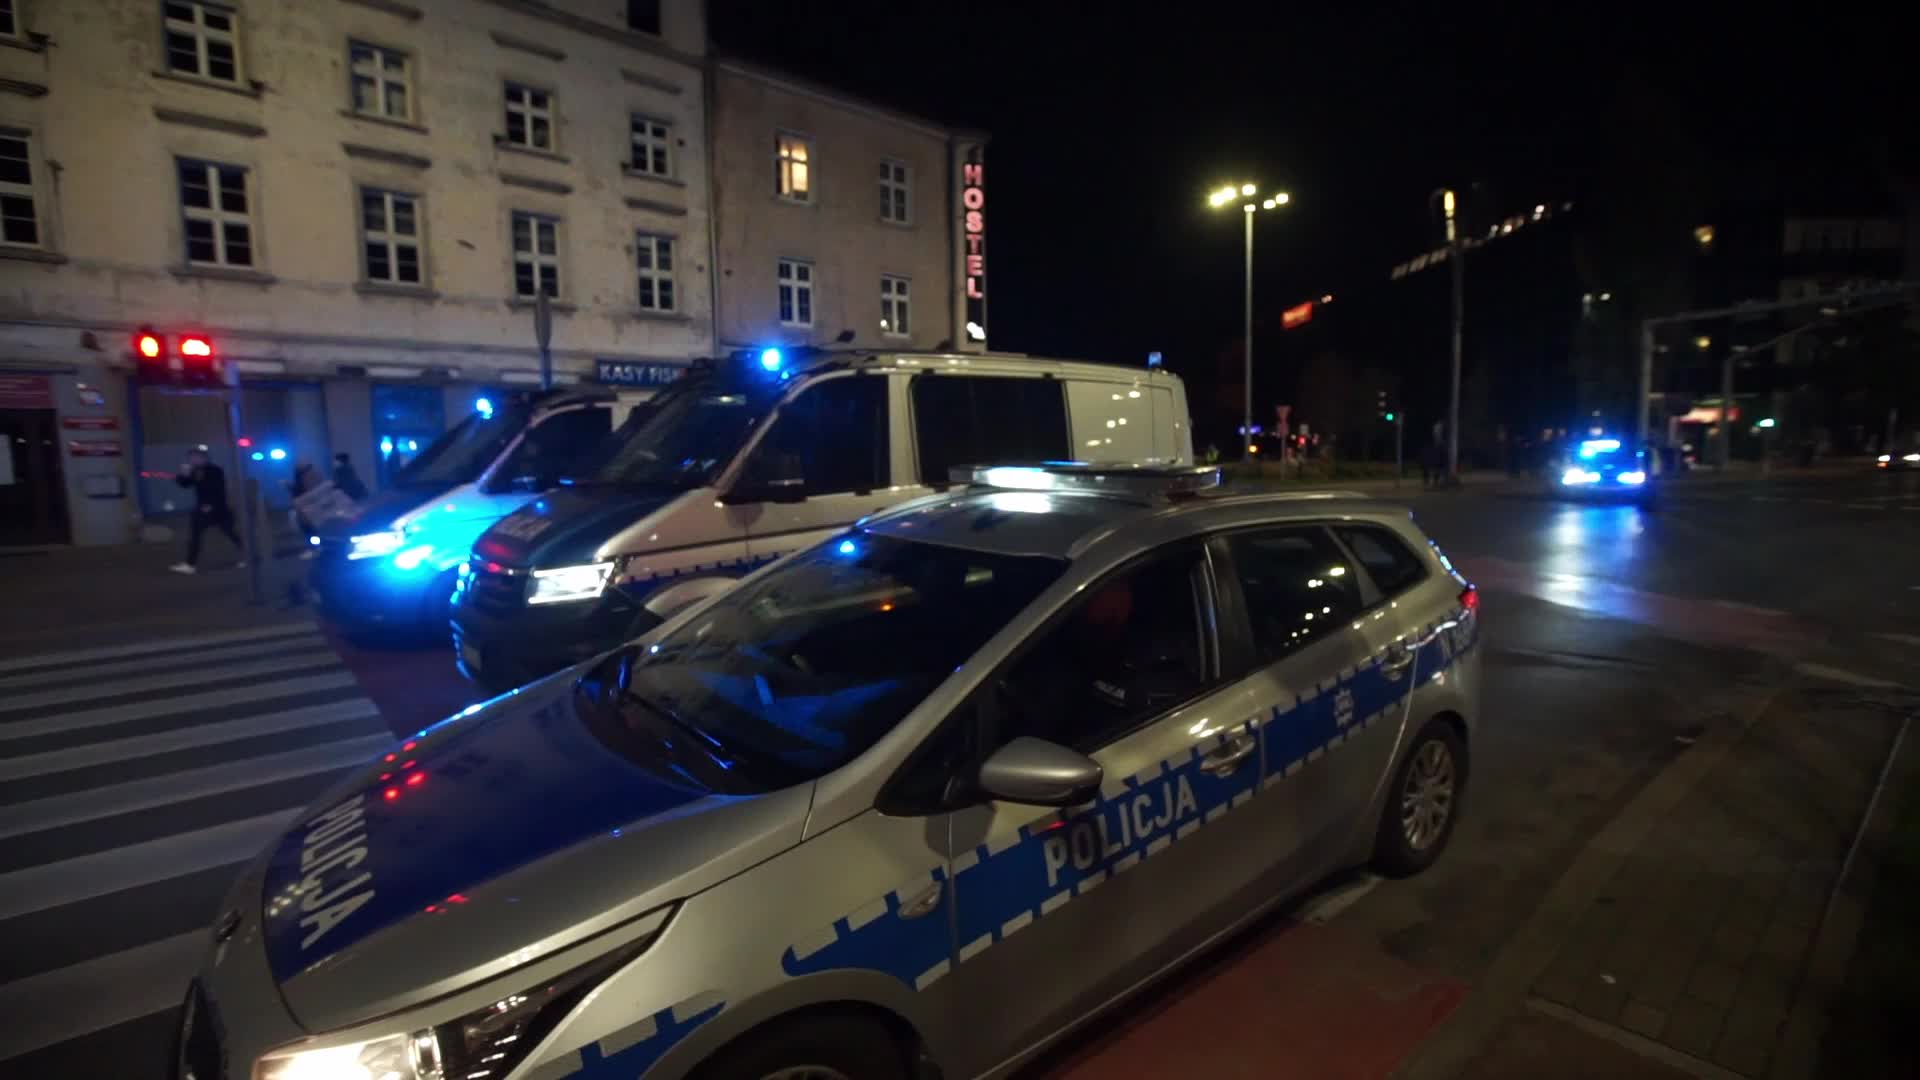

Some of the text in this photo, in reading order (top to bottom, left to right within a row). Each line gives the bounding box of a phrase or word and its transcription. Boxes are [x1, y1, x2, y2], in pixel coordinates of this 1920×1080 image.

[963, 164, 984, 299] HOSTEL
[600, 365, 646, 380] KASY
[299, 793, 376, 950] POLICJA
[1043, 774, 1198, 888] POLICJA
